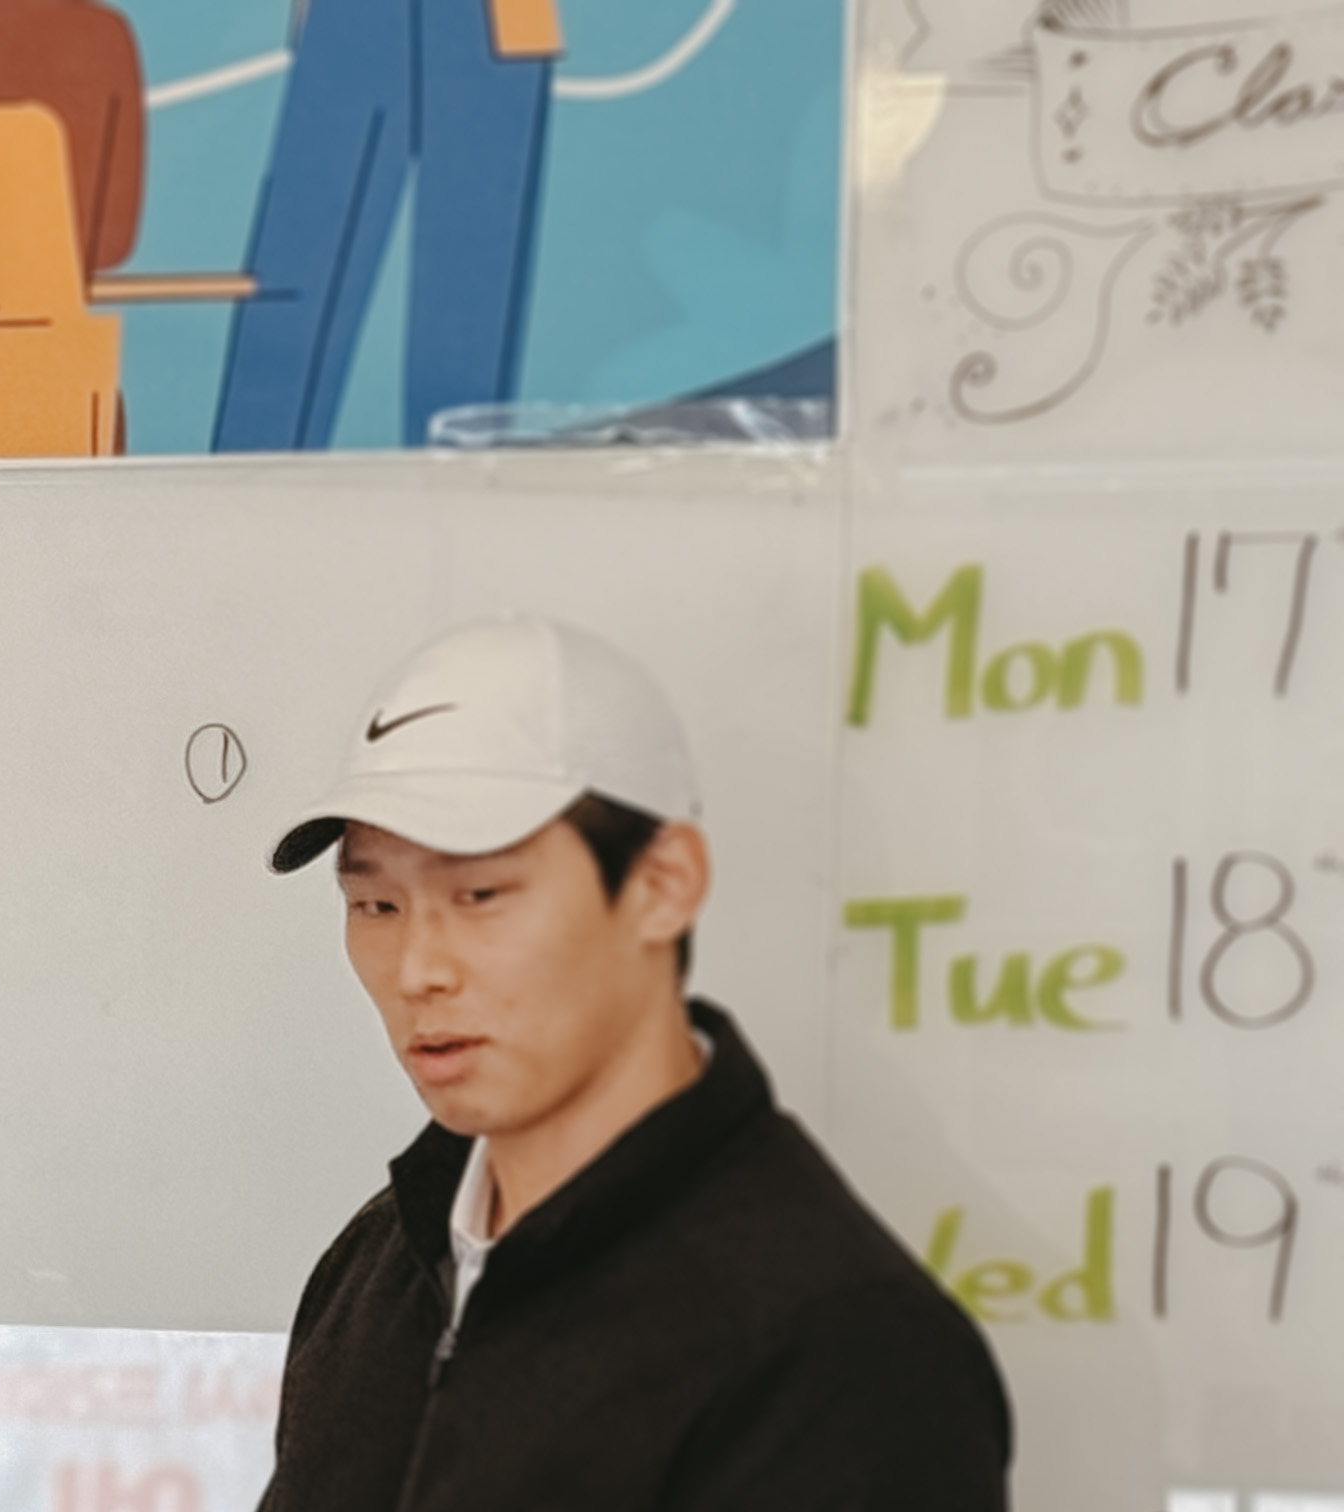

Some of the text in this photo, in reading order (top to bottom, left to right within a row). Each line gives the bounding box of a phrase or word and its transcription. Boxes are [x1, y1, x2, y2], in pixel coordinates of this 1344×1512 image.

[846, 562, 1145, 730] Mon
[842, 893, 1132, 1034] Tue
[919, 1184, 1116, 1325] ed
